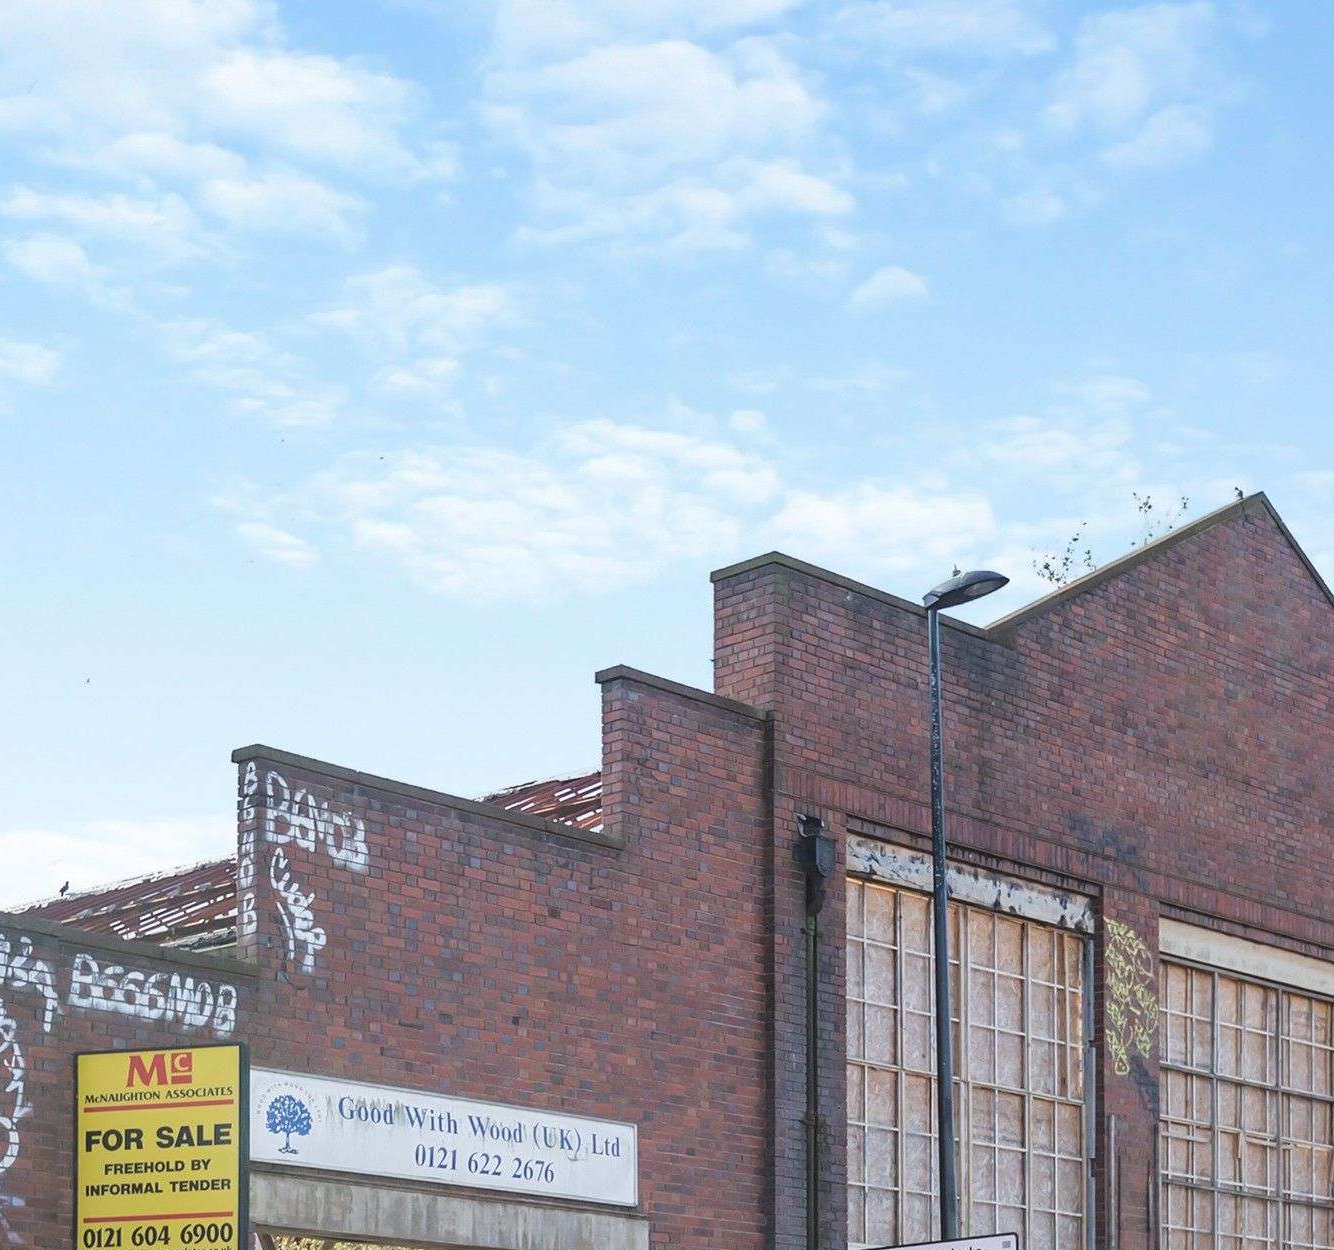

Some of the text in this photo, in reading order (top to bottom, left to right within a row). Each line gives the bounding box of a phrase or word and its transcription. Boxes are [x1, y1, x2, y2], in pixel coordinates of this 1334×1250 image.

[84, 1086, 234, 1105] McNAUGHTON ASSOCIATES
[85, 1123, 232, 1152] FOR SALE
[337, 1095, 396, 1125] Good
[404, 1105, 458, 1135] With
[466, 1114, 524, 1143] Wood
[532, 1121, 581, 1152] (UK)
[591, 1132, 621, 1158] Ltd
[104, 1158, 212, 1176] FREEHOLD BY
[414, 1143, 555, 1184] 0121 622 2676
[85, 1178, 232, 1197] INFORMAL TENDER
[83, 1222, 234, 1249] 0121 604 6900
